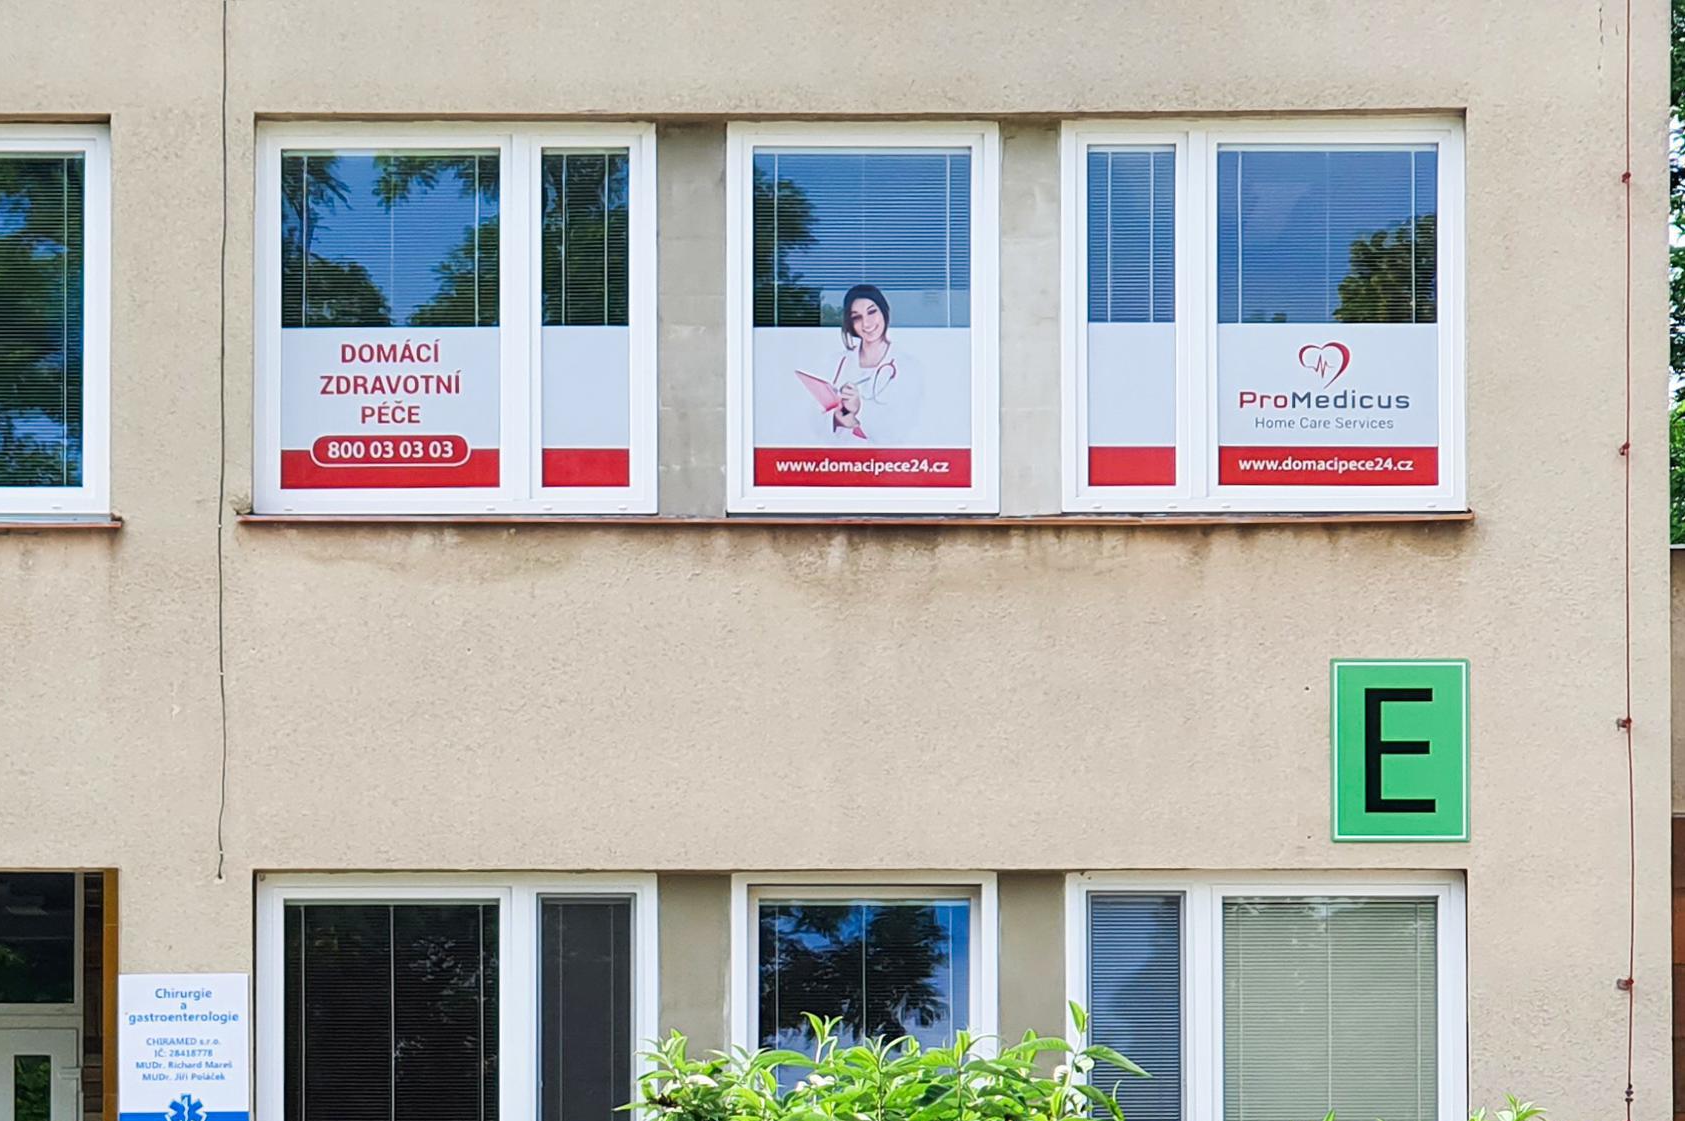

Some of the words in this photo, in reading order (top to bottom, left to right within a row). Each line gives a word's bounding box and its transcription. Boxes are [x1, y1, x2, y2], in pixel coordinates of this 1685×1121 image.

[340, 339, 440, 364] DOMÁCÍ
[320, 370, 462, 395] ZDRAVOTNÍ
[1239, 390, 1410, 409] ProMedicus
[360, 400, 421, 425] PÉČE
[1255, 417, 1295, 429] Home
[1299, 417, 1330, 429] Care
[1335, 417, 1394, 429] Services
[327, 441, 364, 459] 800
[368, 441, 393, 459] 03
[399, 441, 423, 459] 03
[428, 441, 453, 459] 03
[776, 458, 949, 476] www.domacipece24.cz
[1239, 456, 1414, 474] www.domacipece24.cz
[1365, 688, 1436, 813] E
[155, 988, 212, 1000] Chirurgie
[180, 1002, 187, 1010] a
[128, 1011, 239, 1025] gastroenterologie
[135, 1061, 165, 1069] MUDr.
[168, 1061, 203, 1069] Richard
[142, 1073, 171, 1081] MUDr.
